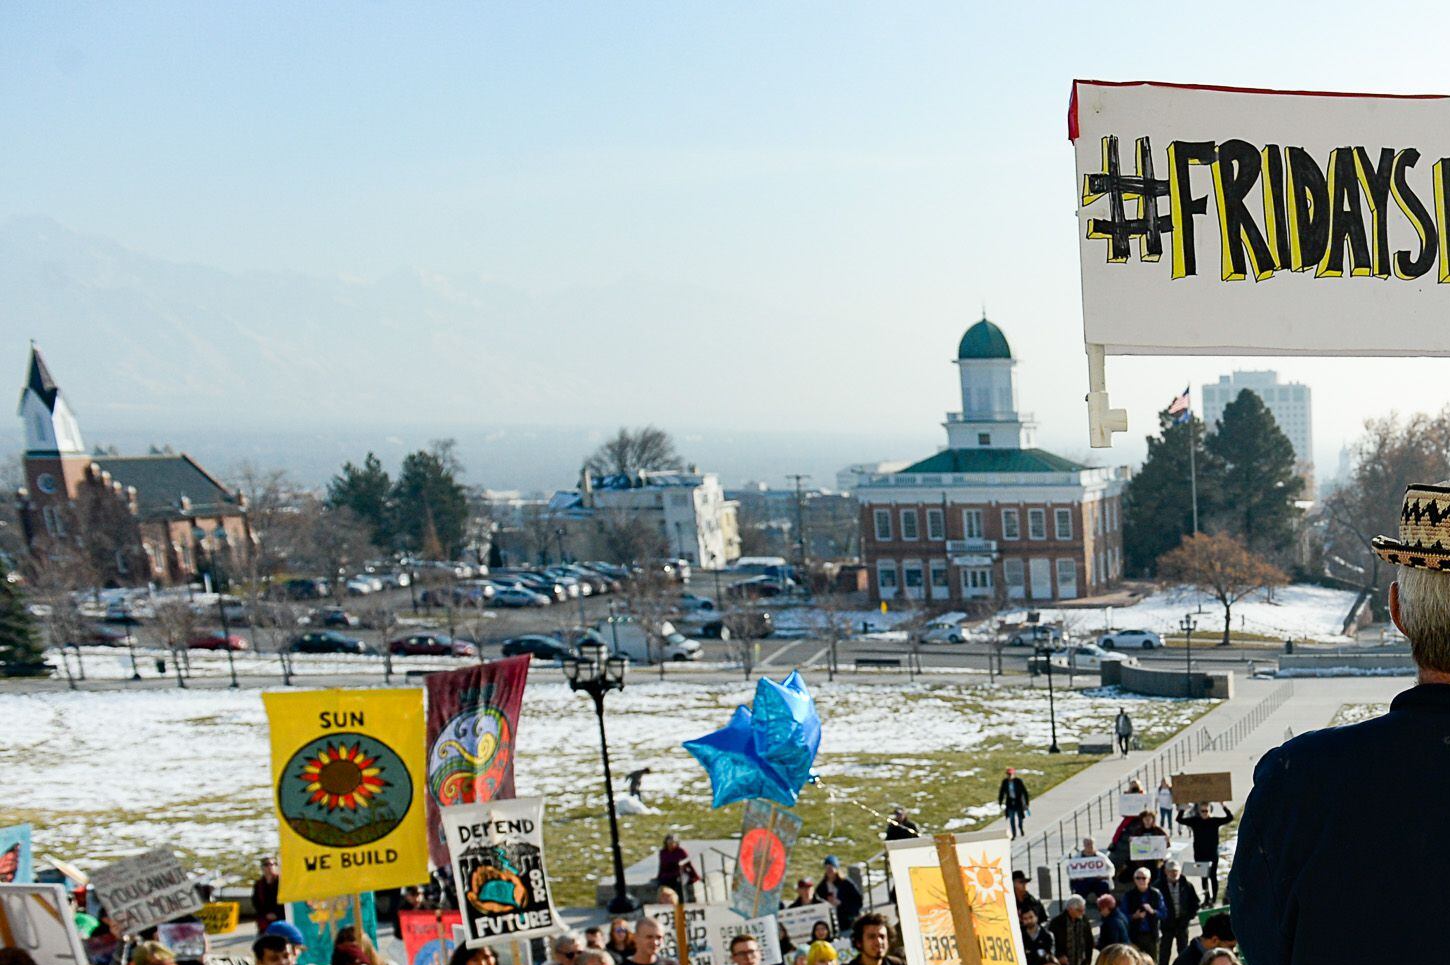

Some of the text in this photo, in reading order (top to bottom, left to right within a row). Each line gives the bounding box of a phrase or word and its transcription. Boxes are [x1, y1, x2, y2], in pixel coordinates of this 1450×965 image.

[320, 711, 365, 728] SUN
[458, 819, 534, 843] DEFEND
[305, 849, 397, 871] WE BUILD
[1070, 860, 1104, 870] WWGD
[529, 869, 546, 903] OUR
[475, 909, 552, 938] FUTURE
